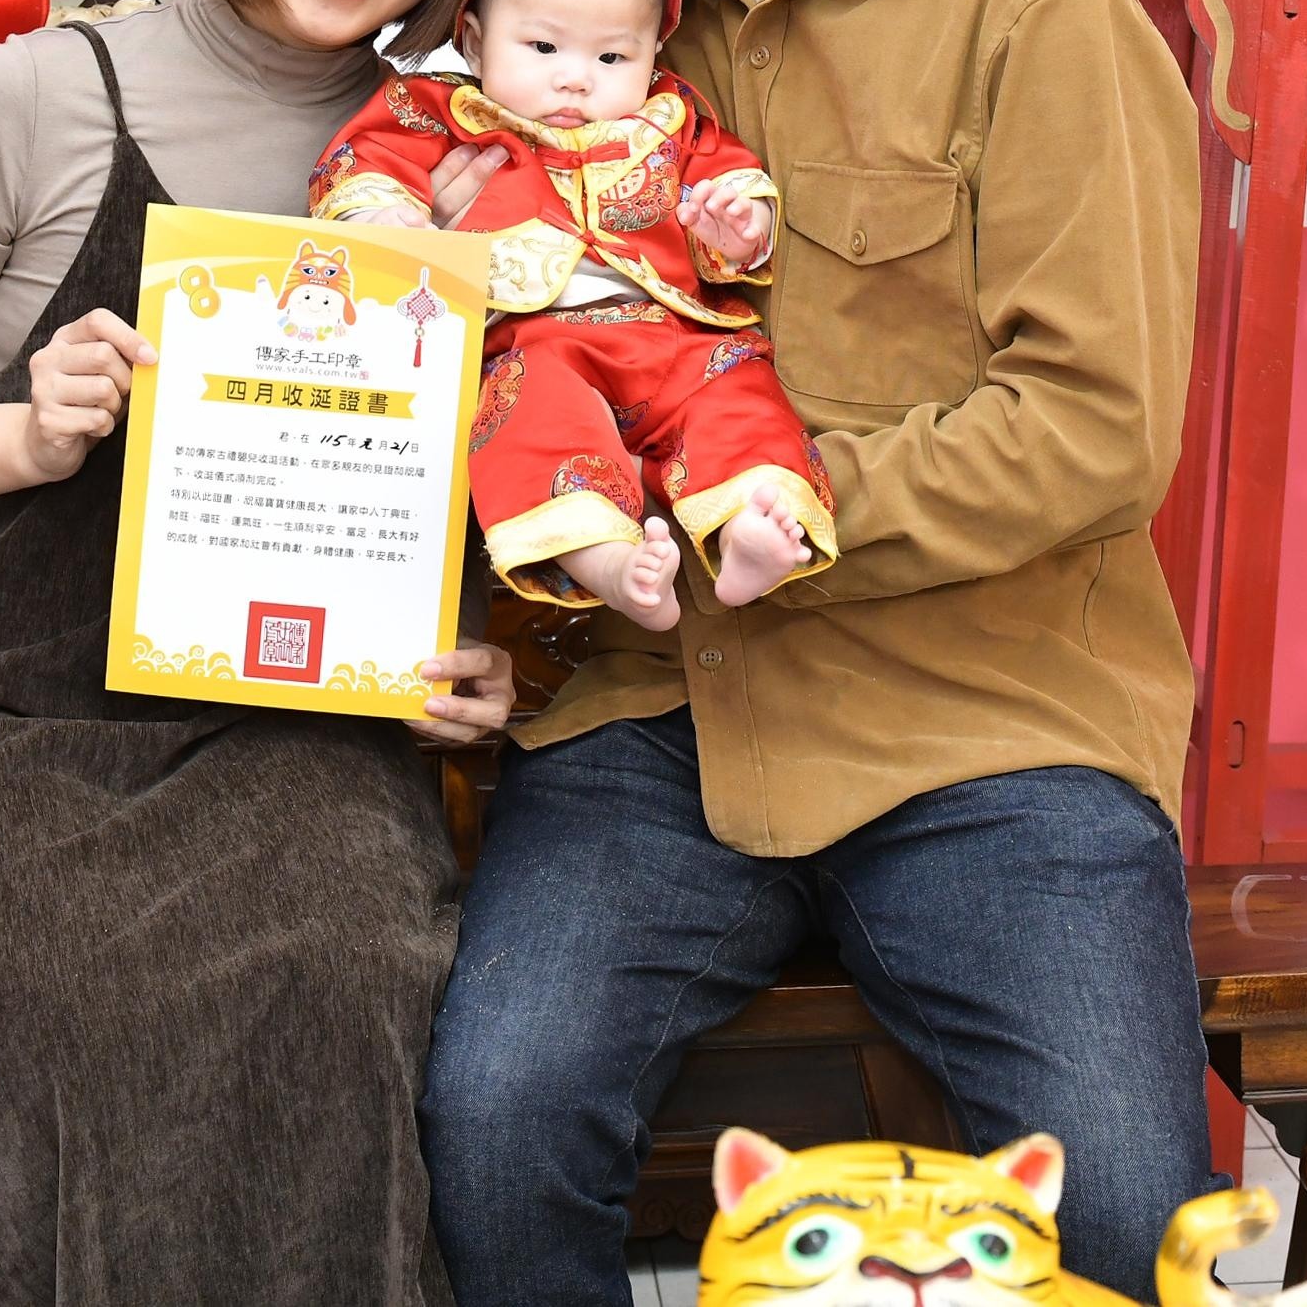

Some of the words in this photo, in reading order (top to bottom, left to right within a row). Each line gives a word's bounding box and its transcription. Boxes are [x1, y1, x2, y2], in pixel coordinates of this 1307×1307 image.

[255, 345, 363, 369] 傳家手工印章
[255, 363, 358, 379] www.seals.com.tw
[226, 380, 389, 414] 四月收涎證書
